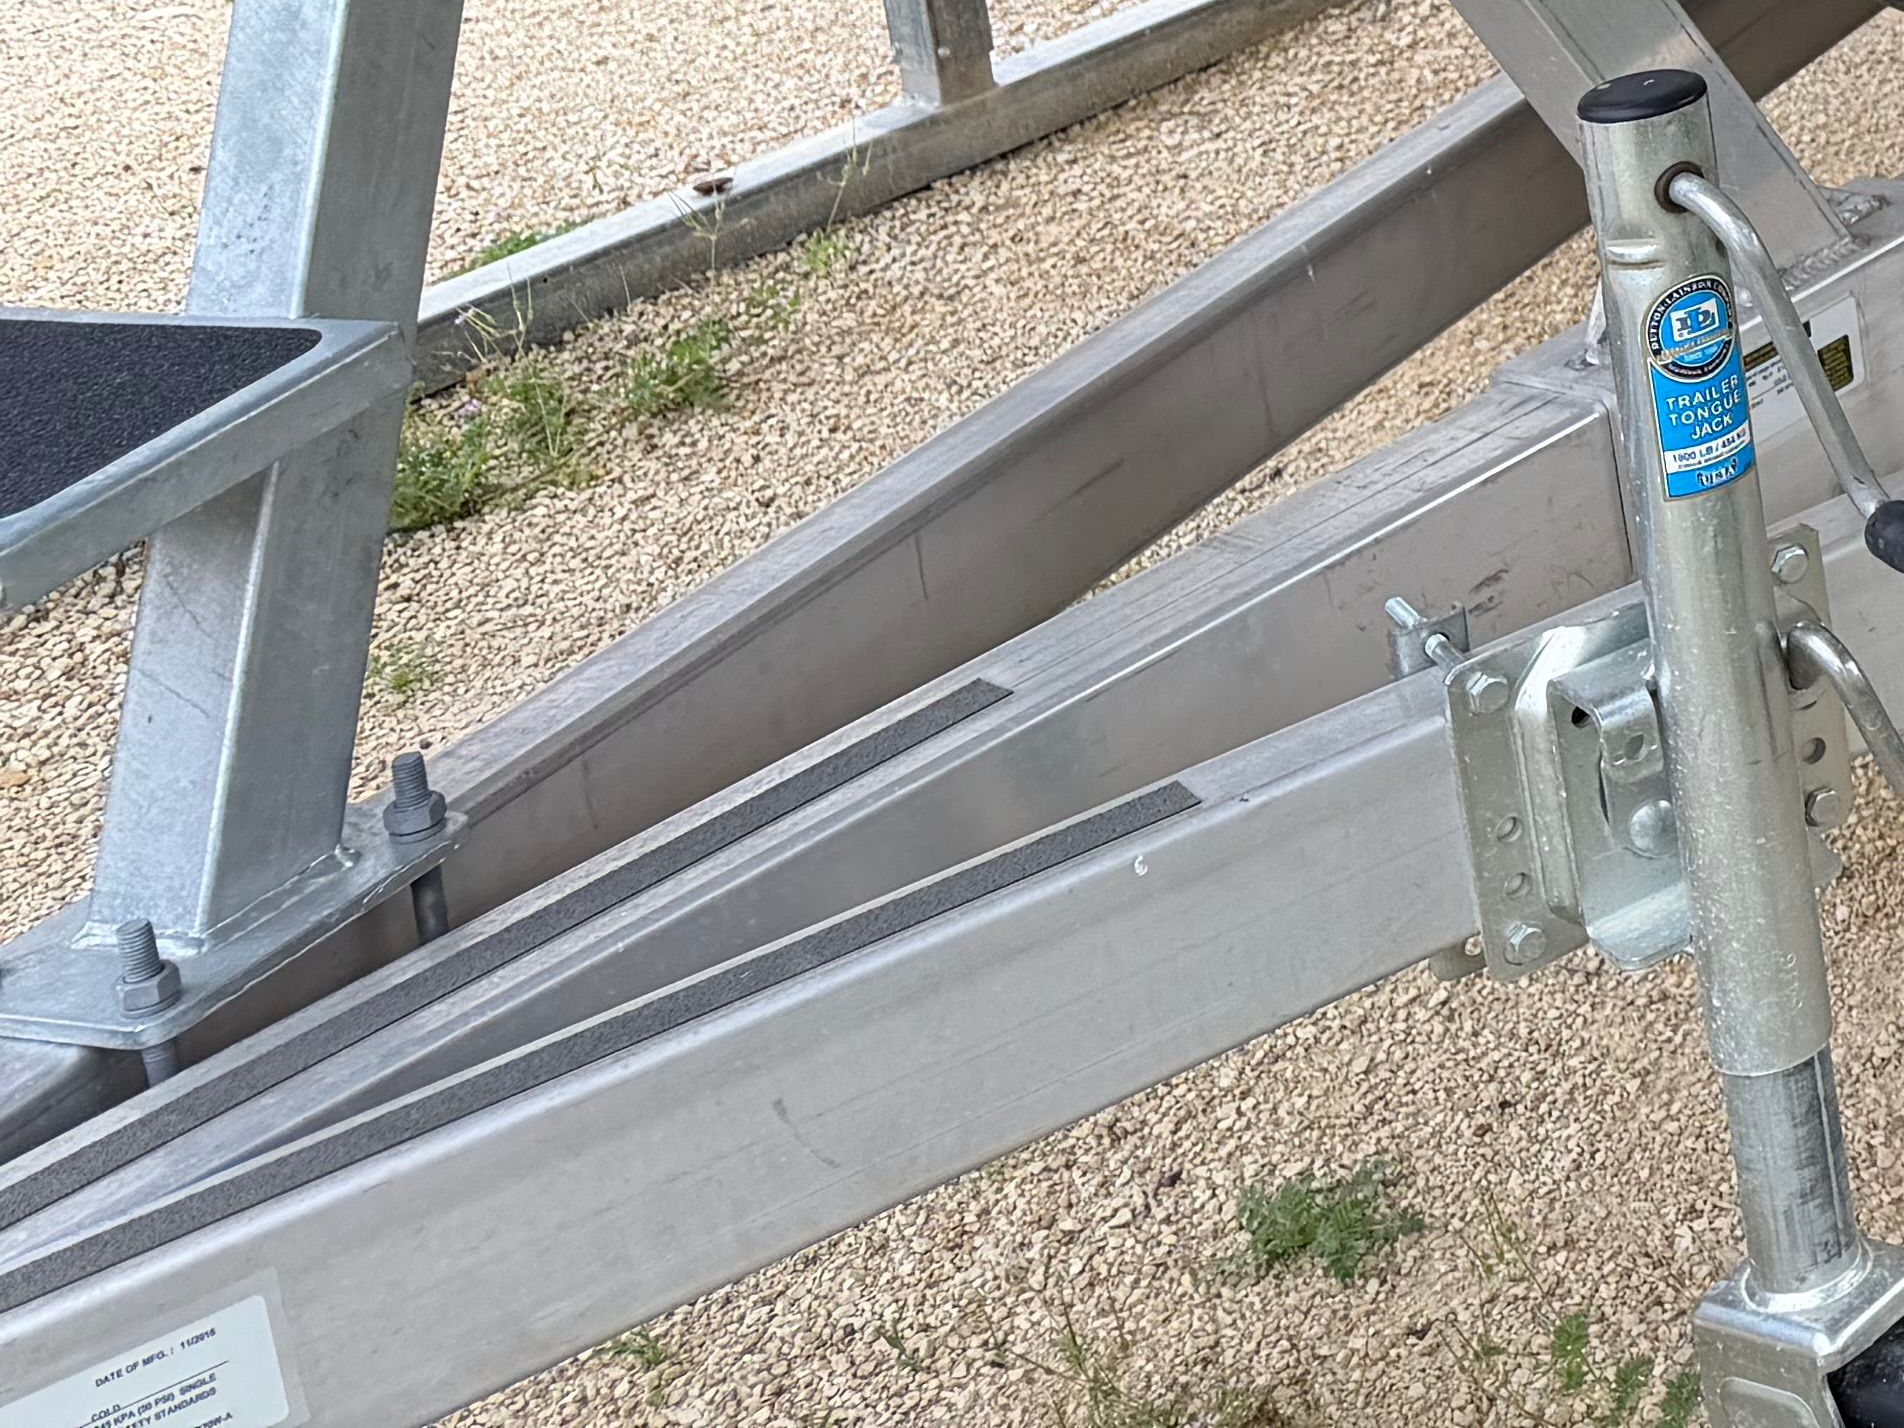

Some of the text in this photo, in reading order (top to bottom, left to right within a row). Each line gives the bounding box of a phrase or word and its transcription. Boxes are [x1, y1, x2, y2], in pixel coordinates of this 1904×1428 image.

[1666, 374, 1738, 410] TRAILER
[1669, 389, 1740, 426] TONGUE
[1692, 412, 1732, 440] JACK
[95, 1368, 123, 1388] DATE
[125, 1361, 139, 1375] OF
[91, 1404, 121, 1423] COLD
[113, 1411, 136, 1428] KPA
[179, 1373, 217, 1396] SINGLE
[155, 1387, 217, 1421] STANDARDS
